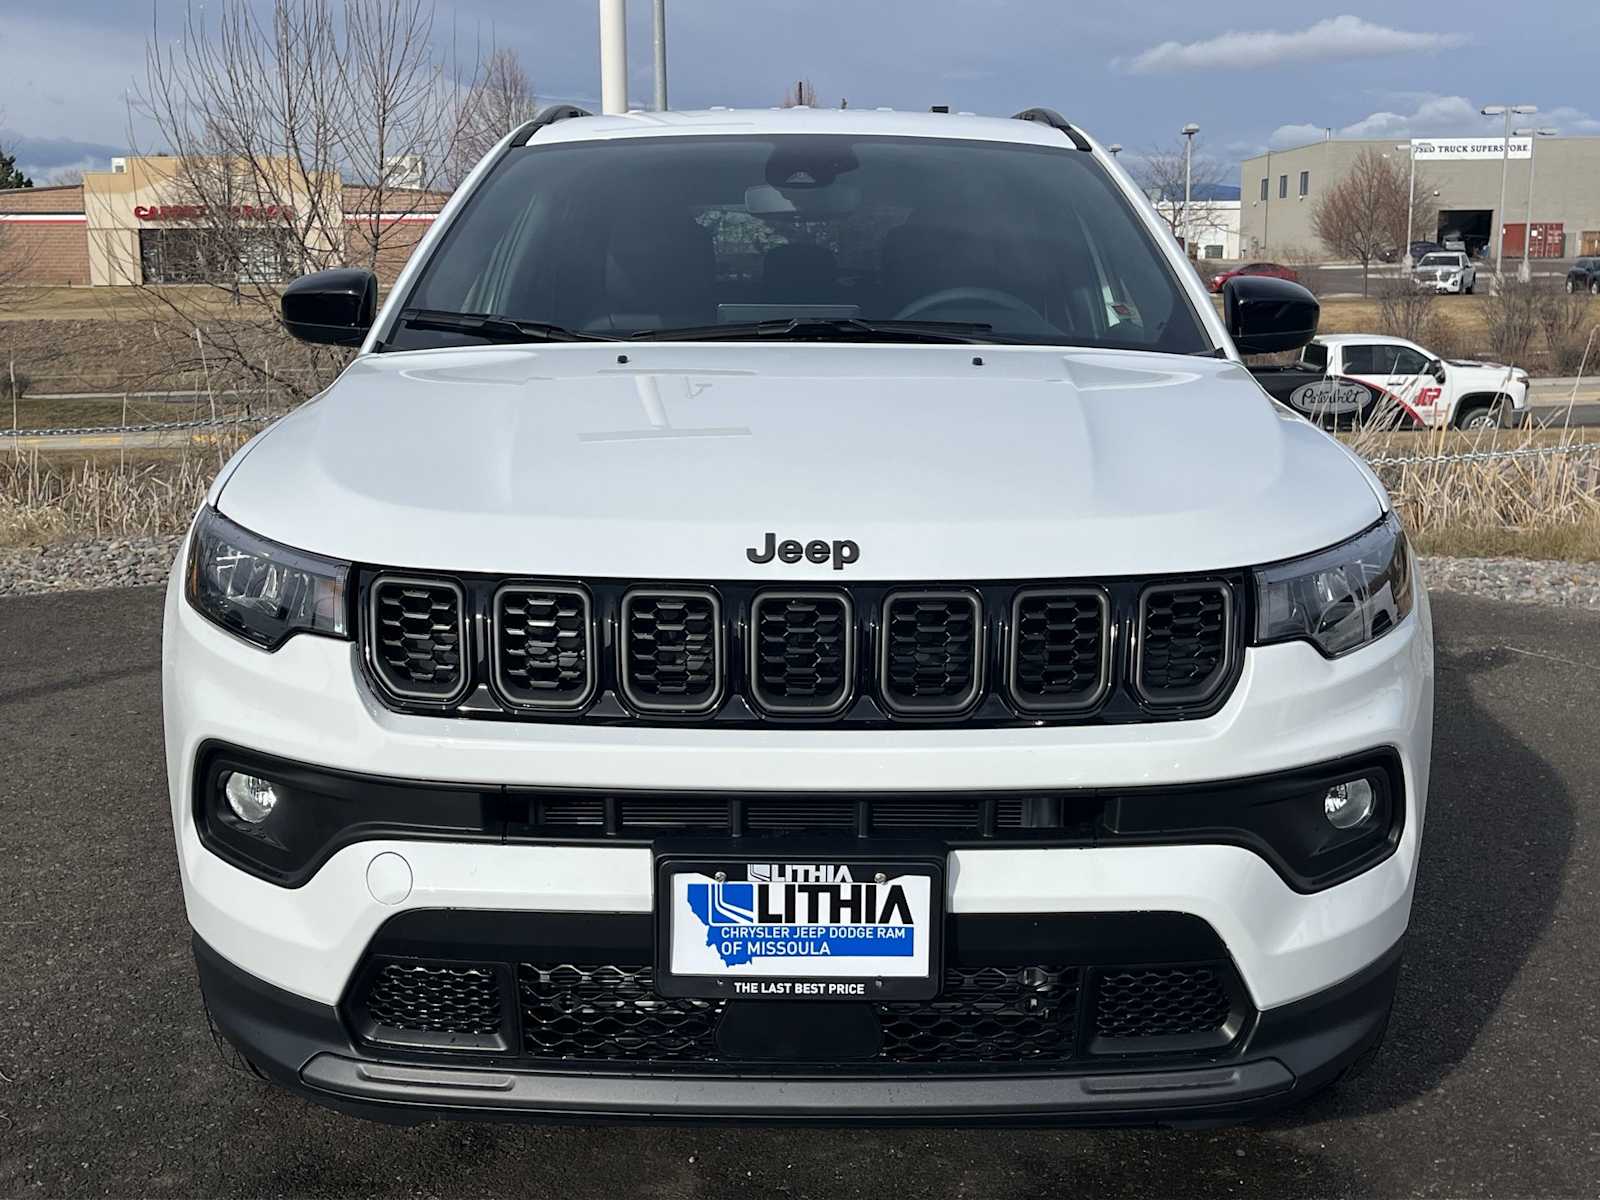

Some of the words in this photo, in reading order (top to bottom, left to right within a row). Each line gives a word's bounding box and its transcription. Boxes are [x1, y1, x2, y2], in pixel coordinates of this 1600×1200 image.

[1438, 145, 1468, 153] TRUCK
[746, 533, 860, 570] Jeep
[770, 864, 853, 883] LITHIA
[757, 884, 914, 925] LITHIA
[721, 927, 789, 938] CHRYSLER
[793, 927, 826, 938] JEEP
[829, 927, 873, 939] DODGE
[877, 927, 905, 939] RAM
[721, 942, 743, 955] OF
[747, 942, 831, 956] MISSOULA
[734, 982, 758, 993] THE
[761, 983, 792, 994] LAST
[795, 983, 825, 994] BEST
[828, 984, 865, 995] PRICE
